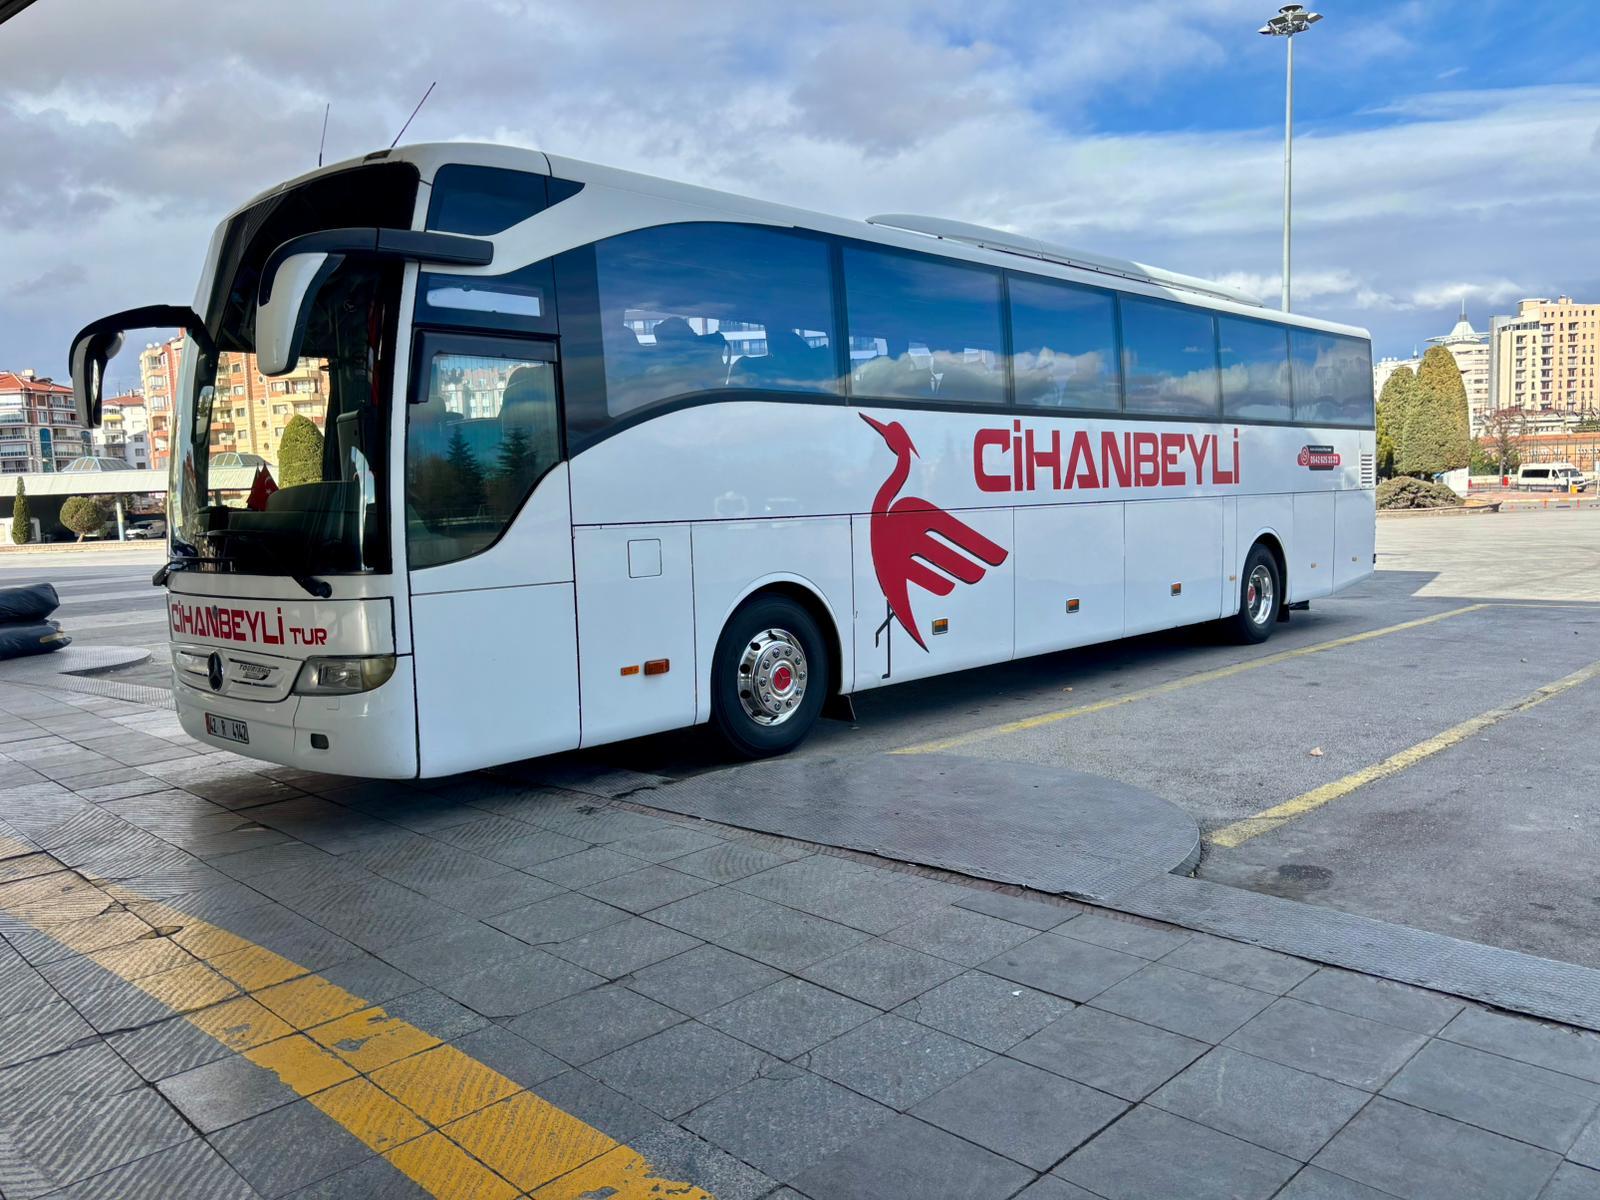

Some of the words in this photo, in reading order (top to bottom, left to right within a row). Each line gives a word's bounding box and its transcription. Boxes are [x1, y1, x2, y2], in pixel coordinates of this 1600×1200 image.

[973, 419, 1240, 492] CİHANBEYLİ
[171, 600, 285, 645] CİHANBEYLİ
[289, 627, 328, 646] TUR
